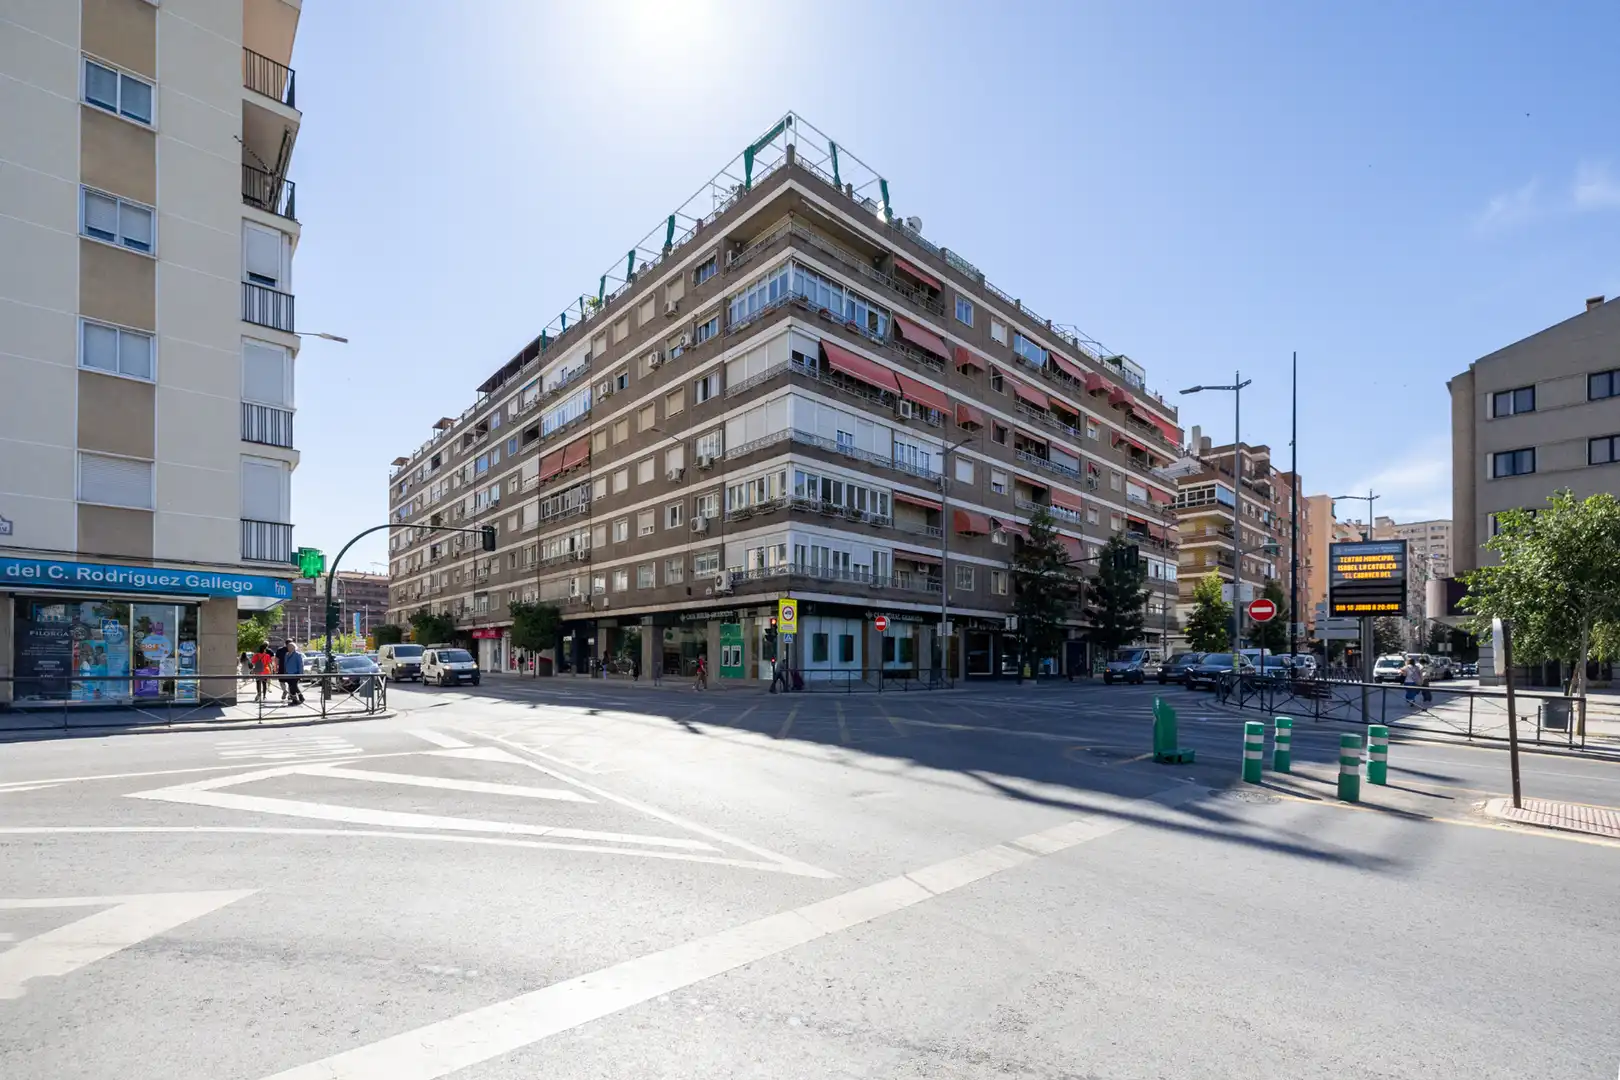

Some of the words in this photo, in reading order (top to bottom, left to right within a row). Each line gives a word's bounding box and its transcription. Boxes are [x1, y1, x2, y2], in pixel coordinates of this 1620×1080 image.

[6, 563, 41, 578] del
[48, 565, 69, 580] C.
[77, 567, 181, 587] Rodríguez
[185, 575, 253, 593] Gallego
